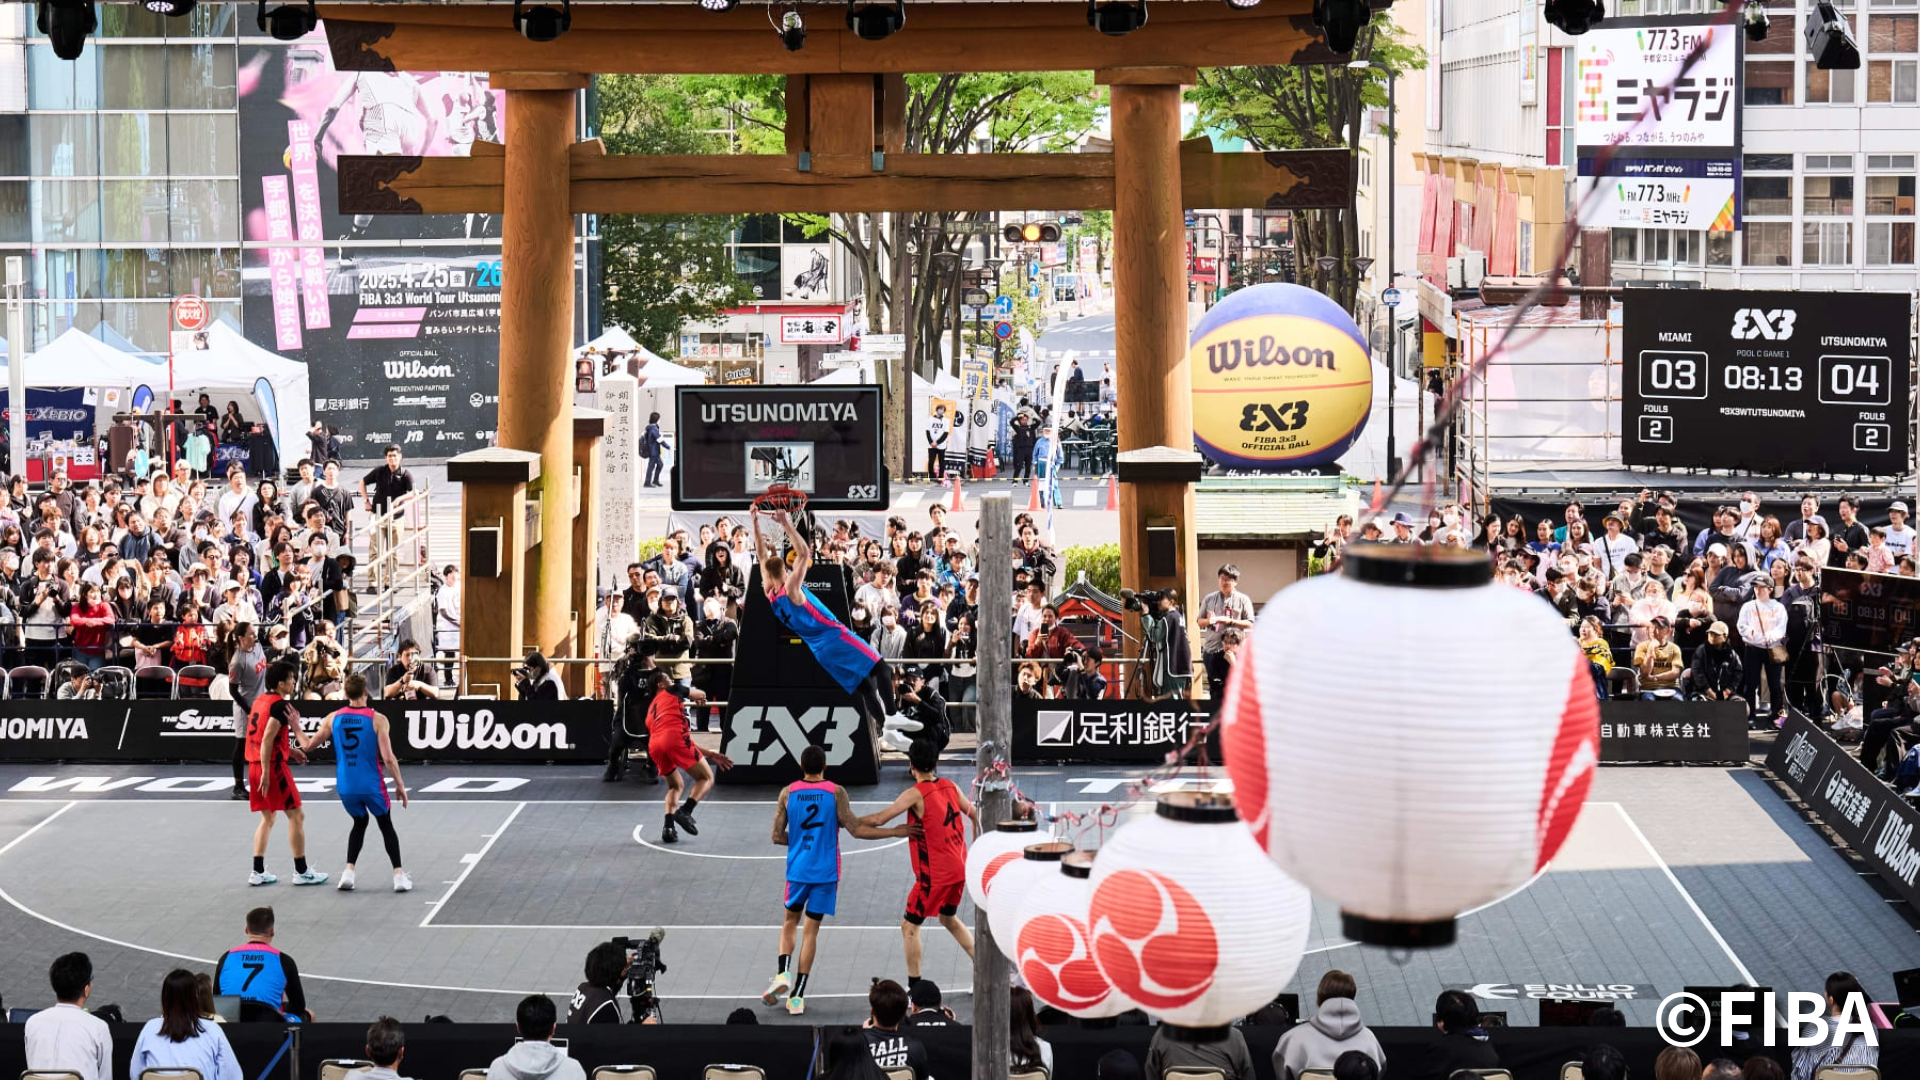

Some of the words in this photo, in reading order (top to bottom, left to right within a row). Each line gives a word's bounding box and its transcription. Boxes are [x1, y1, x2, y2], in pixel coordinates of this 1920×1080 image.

[1648, 29, 1680, 51] 77.3
[1616, 77, 1734, 121] ミヤラジ
[1638, 184, 1665, 202] 77.3
[1666, 193, 1681, 203] MHz
[291, 122, 328, 327] 世界一を決める戦いが
[1653, 209, 1690, 224] ミヤラジ
[266, 179, 299, 346] 宇都宮から始まる
[358, 262, 449, 288] 2025.4.25
[359, 293, 382, 306] FIBA
[384, 293, 403, 305] 3x3
[405, 292, 433, 304] World
[436, 292, 456, 303] Tour
[1658, 332, 1692, 343] MIAMI
[1820, 336, 1887, 348] UTSUNOMIYA
[1207, 335, 1337, 375] Wilson
[1736, 350, 1755, 358] POOL
[1763, 350, 1785, 358] GAME
[383, 360, 452, 379] Wilson
[1651, 359, 1697, 390] 03
[1724, 365, 1802, 391] 08:13
[1831, 364, 1880, 396] 04
[328, 398, 370, 411] 足利銀行
[701, 402, 859, 423] UTSUNOMIYA
[1643, 404, 1669, 413] FOULS
[1720, 407, 1806, 419] #3X3WTUTSUNOMIYA
[1858, 412, 1886, 421] FOULS
[404, 430, 424, 444] JTB
[445, 432, 464, 440] TKC
[1650, 420, 1662, 438] 2
[1865, 428, 1879, 446] 2
[1241, 442, 1286, 451] OFFICIAL
[1288, 440, 1311, 449] BALL
[161, 715, 178, 723] THE
[175, 708, 235, 729] SUPE
[1076, 711, 1211, 745] 足利銀行
[342, 726, 363, 751] 5
[404, 709, 569, 750] Wilson
[1600, 722, 1712, 738] 自動車株式会社
[800, 804, 825, 831] 2
[1874, 808, 1920, 888] Wilson
[241, 954, 265, 962] TRAVIS
[241, 963, 265, 992] 7
[1523, 983, 1636, 992] ENLIO
[1525, 991, 1639, 1000] COURT
